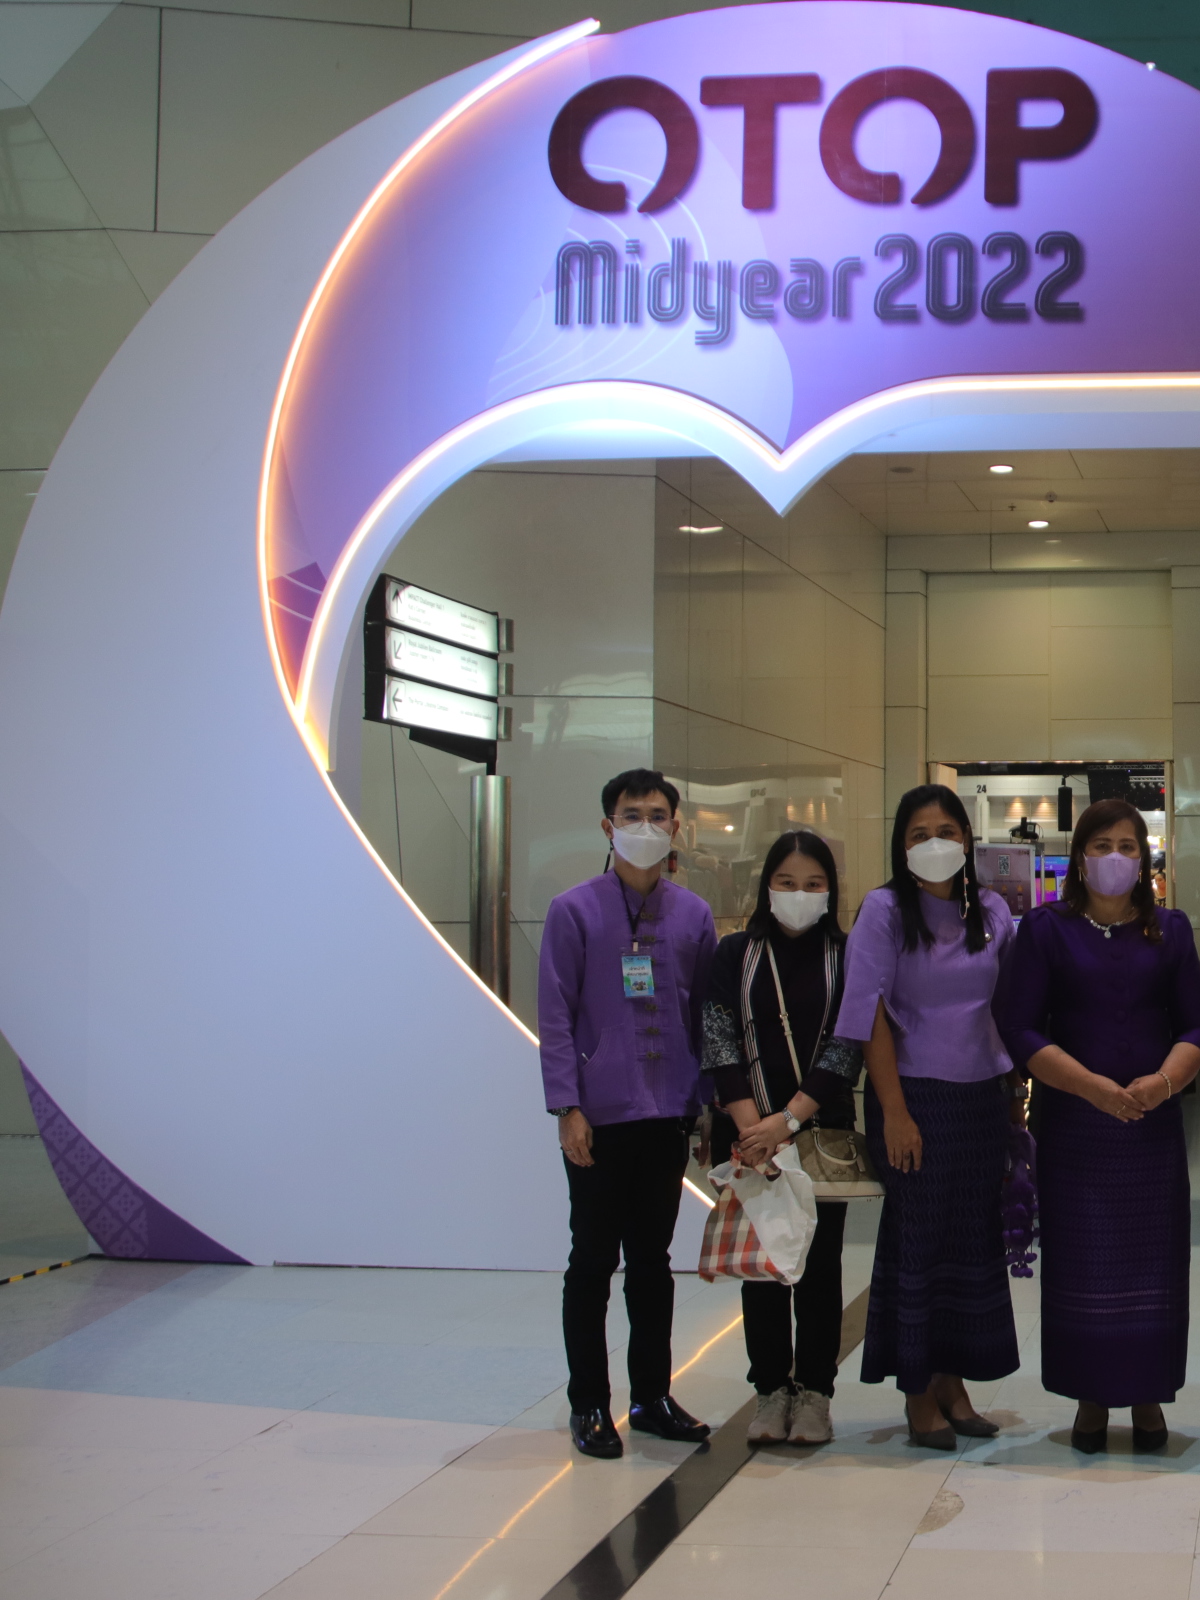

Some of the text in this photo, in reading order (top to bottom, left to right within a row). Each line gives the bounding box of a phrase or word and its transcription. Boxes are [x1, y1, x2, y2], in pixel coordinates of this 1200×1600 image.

[548, 66, 1098, 213] OTOP
[874, 231, 1086, 323] 2022
[976, 784, 987, 794] 24
